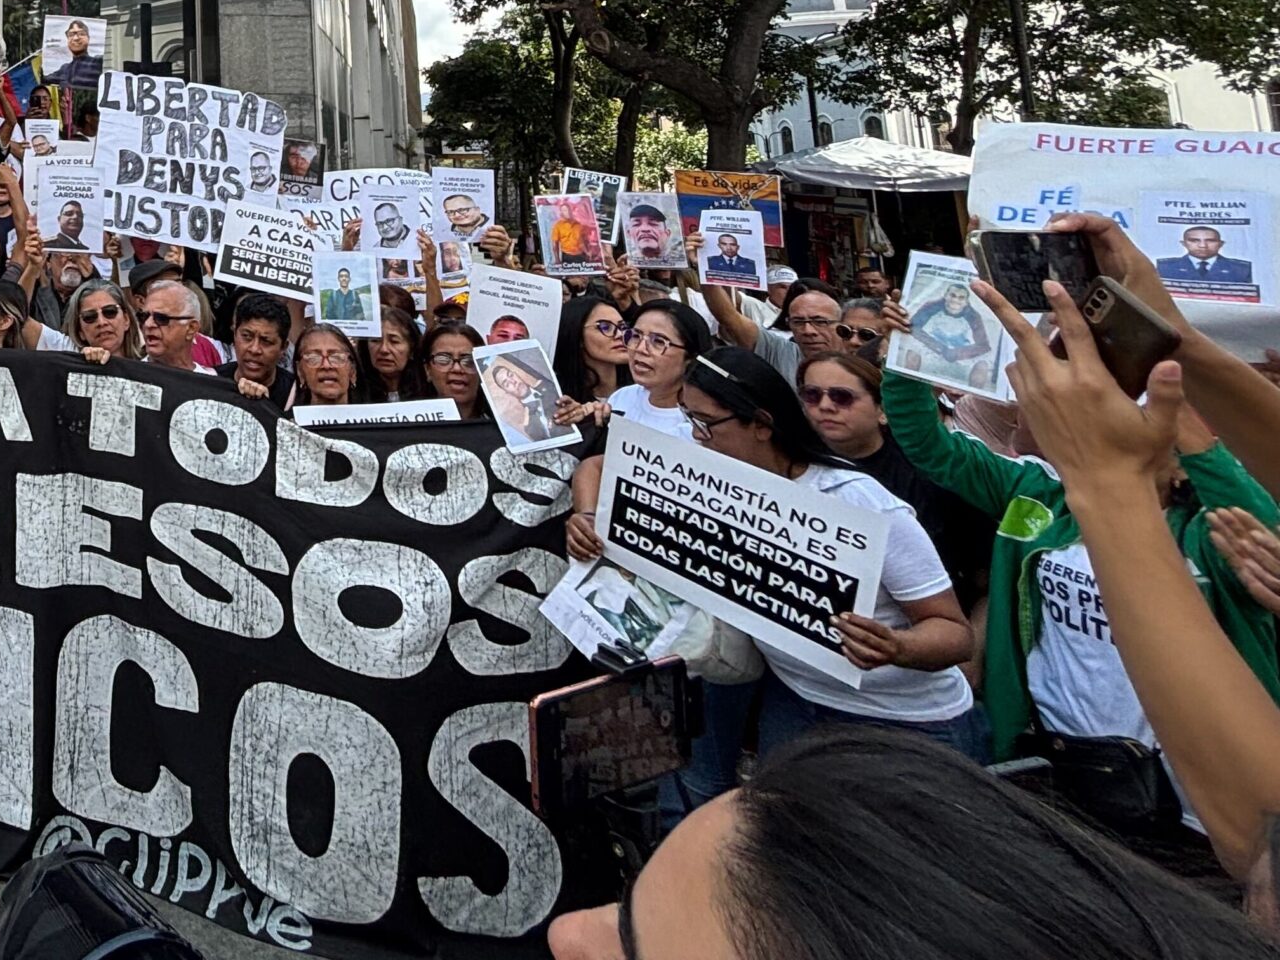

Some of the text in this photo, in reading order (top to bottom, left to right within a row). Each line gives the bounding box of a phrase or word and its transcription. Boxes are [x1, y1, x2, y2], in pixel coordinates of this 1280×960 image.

[98, 72, 287, 135] LIBERTAD
[141, 116, 229, 163] PARA
[1036, 133, 1155, 154] FUERTE
[116, 149, 246, 202] DENYS
[570, 170, 619, 185] LIBERTAD
[53, 191, 95, 199] CARDENAS
[282, 181, 312, 197] SOS
[1039, 186, 1074, 205] FÉ
[235, 208, 294, 228] QUEREMOS
[997, 206, 1036, 223] DE
[239, 238, 265, 251] CON
[248, 224, 314, 252] A CASA
[230, 259, 313, 288] EN LIBERTA
[232, 248, 312, 274] SERES QUERID
[479, 289, 520, 302] MIGUEL ÁNGEL
[501, 285, 530, 295] INMEDIATA
[517, 281, 543, 291] LIBERTAD
[66, 373, 580, 528] TODOS
[621, 440, 867, 551] UNA AMNISTÍA NO ES
[632, 465, 837, 562] PROPAGANDA, ES
[620, 481, 854, 593] LIBERTAD, VERDAD Y
[625, 506, 834, 614] REPARACIÓN PARA
[612, 523, 843, 644] TODAS LAS VÍCTIMAS
